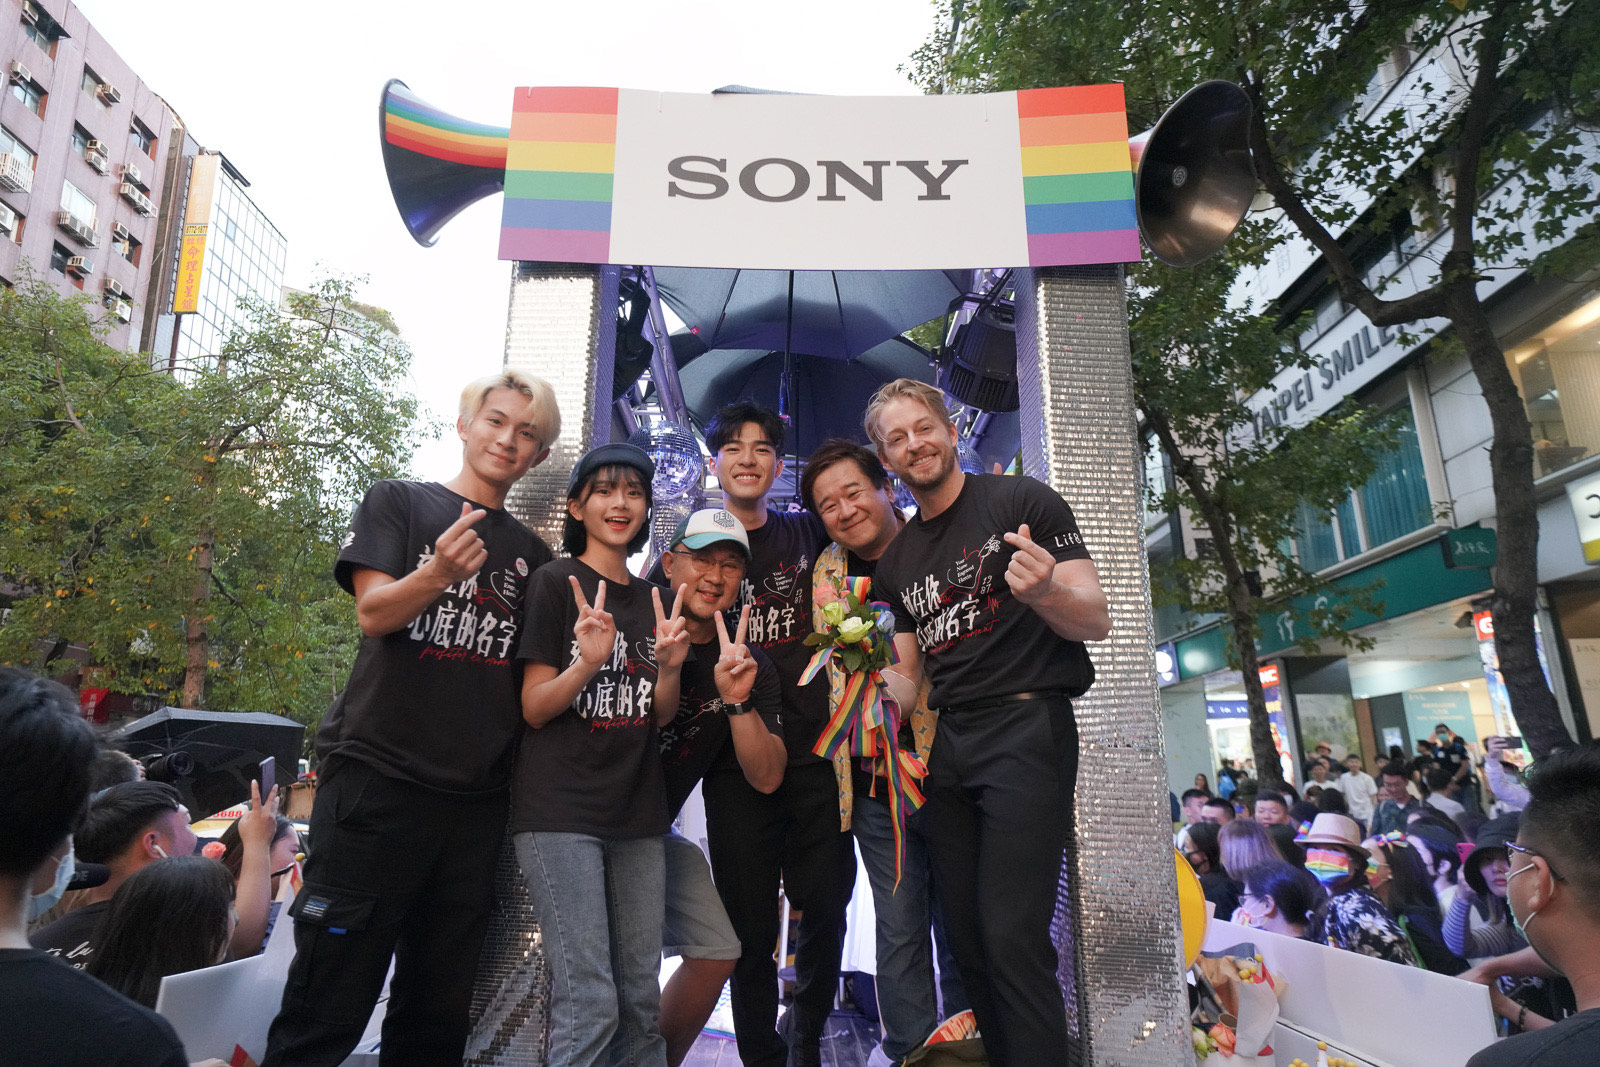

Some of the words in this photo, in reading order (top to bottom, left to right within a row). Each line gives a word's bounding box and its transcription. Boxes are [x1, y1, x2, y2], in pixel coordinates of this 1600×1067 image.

[666, 155, 969, 202] SONY
[1252, 372, 1314, 440] TAIPEI
[406, 600, 517, 658] 心底的名字
[572, 674, 653, 719] 心底的名
[1259, 669, 1278, 684] NC
[209, 810, 242, 818] 5688
